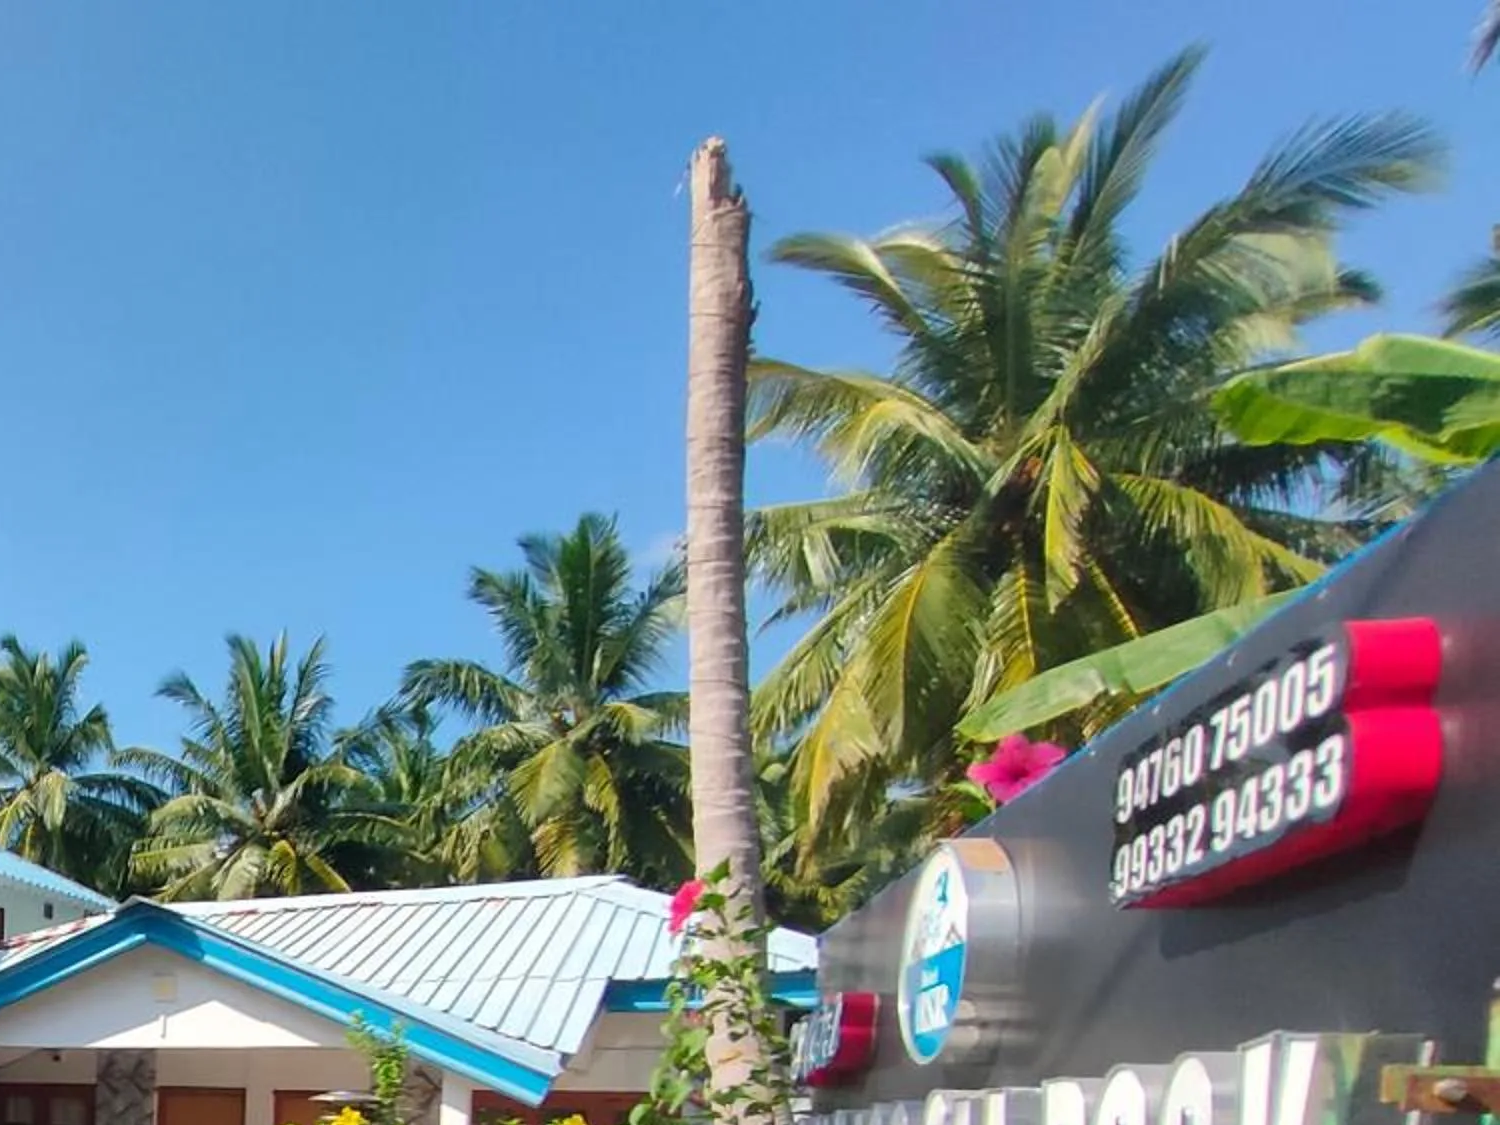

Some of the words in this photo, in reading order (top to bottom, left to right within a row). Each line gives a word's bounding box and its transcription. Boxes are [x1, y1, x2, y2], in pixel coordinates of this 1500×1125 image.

[1113, 803, 1207, 898] 99332
[1211, 733, 1345, 852] 94333
[1116, 723, 1205, 824] 94760
[1209, 643, 1337, 771] 75005
